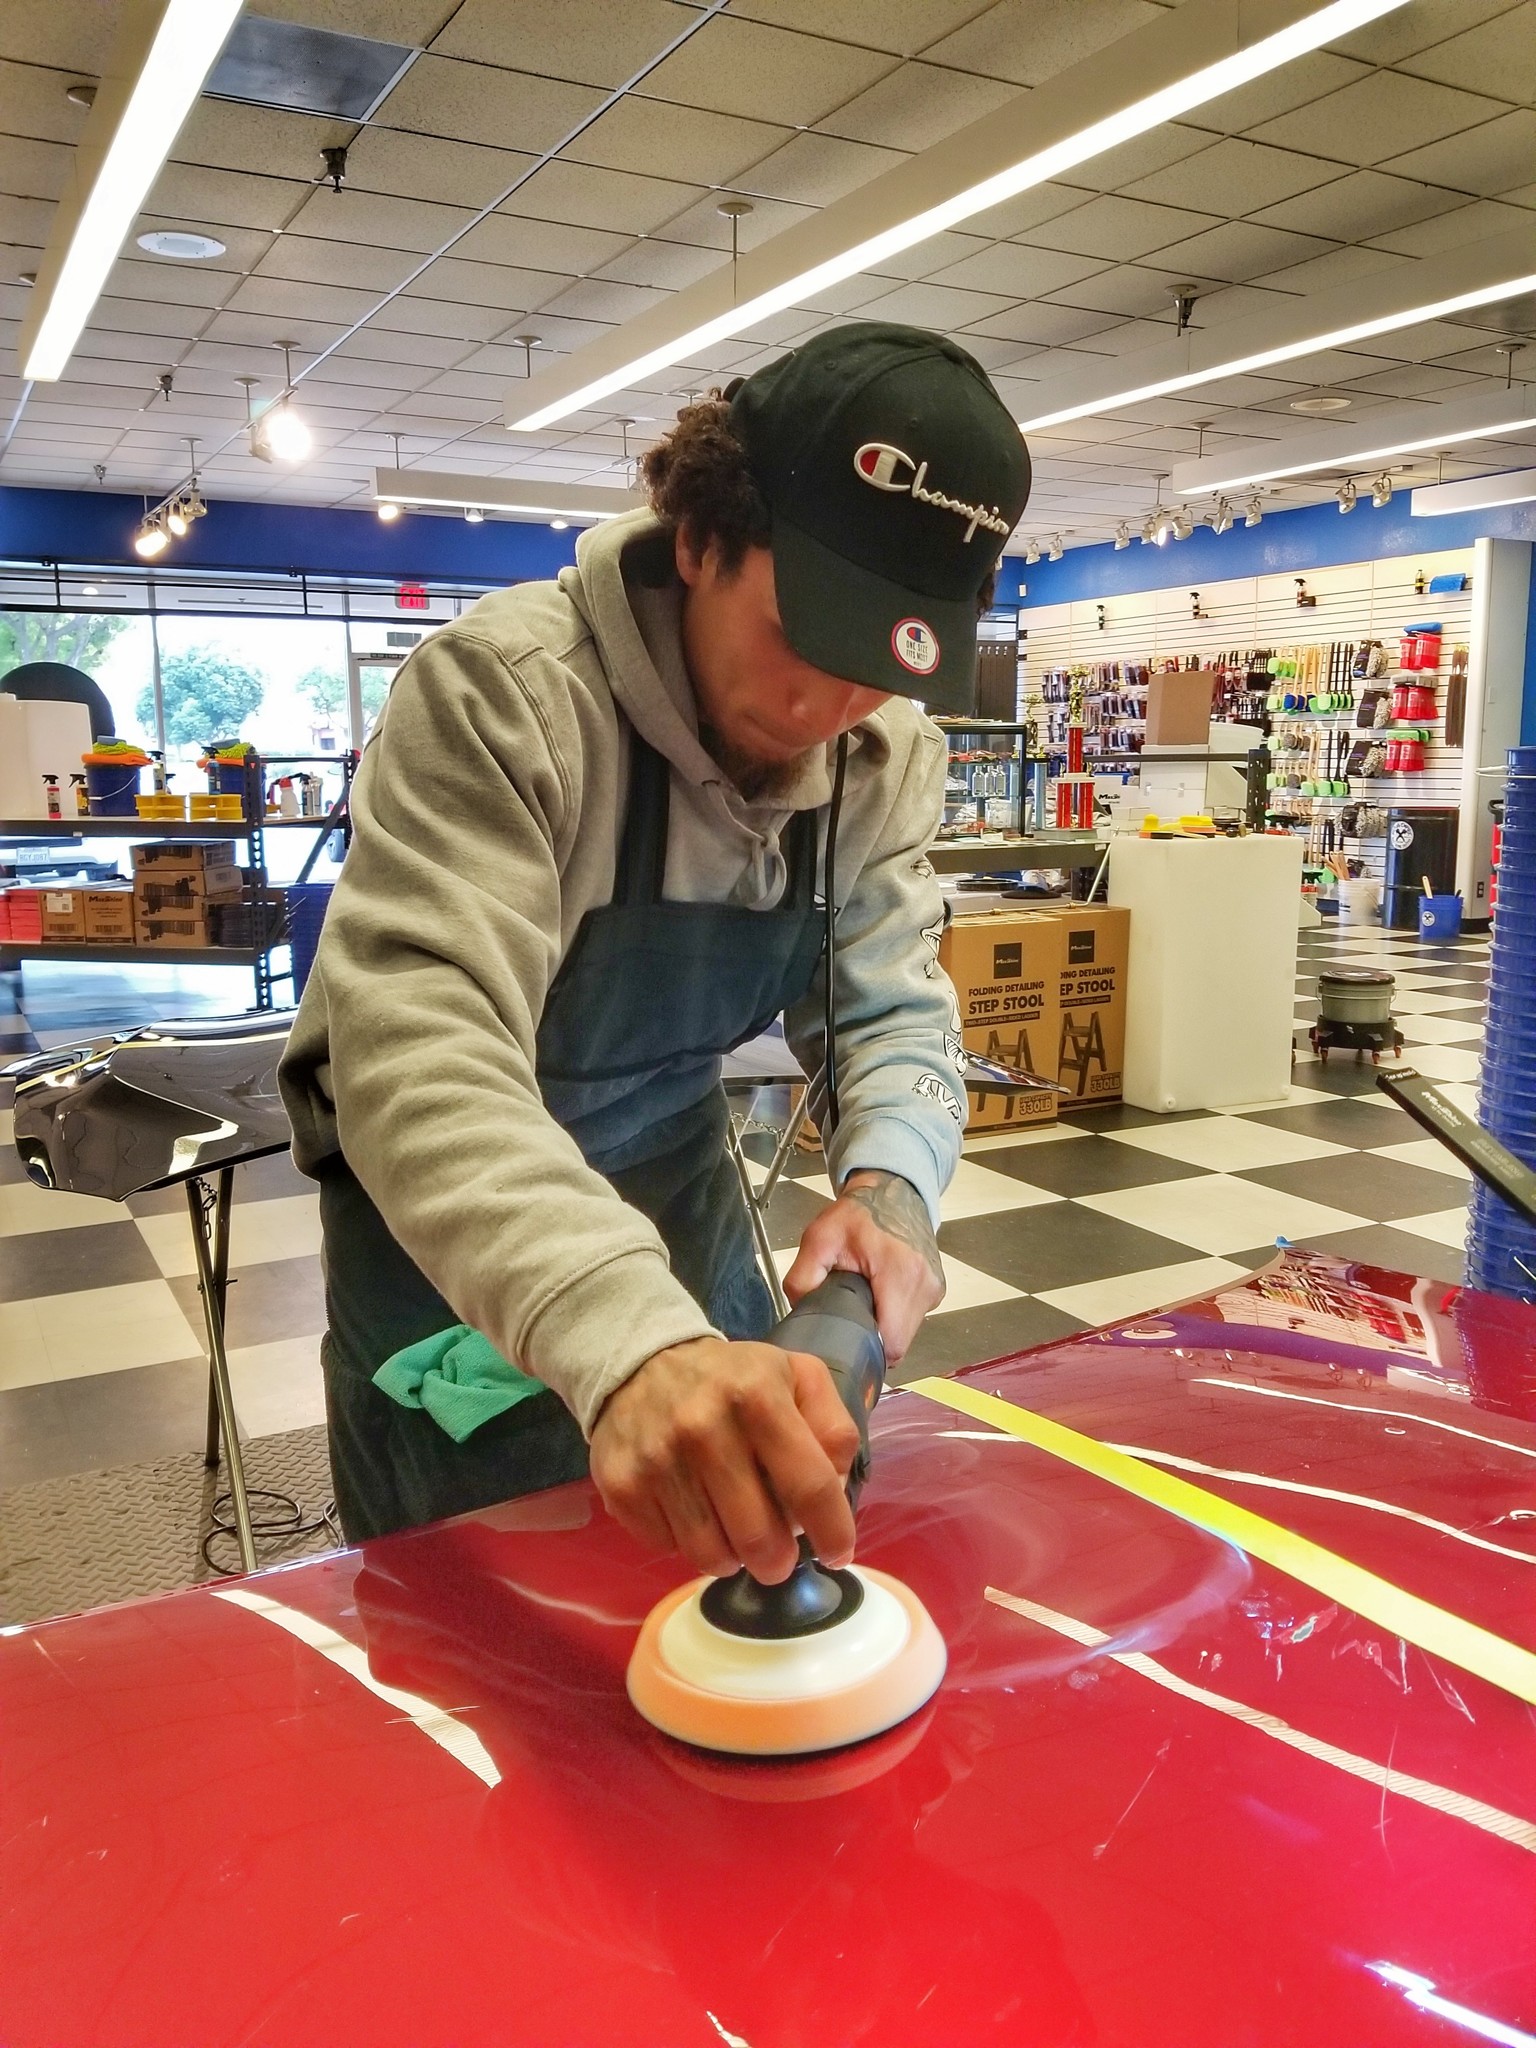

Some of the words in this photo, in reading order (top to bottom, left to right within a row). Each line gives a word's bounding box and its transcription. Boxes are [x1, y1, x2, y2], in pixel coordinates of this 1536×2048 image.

[400, 587, 425, 608] EXIT
[906, 639, 916, 651] ONE
[917, 643, 928, 655] SIZE
[1079, 967, 1115, 977] DETAILING
[968, 985, 1003, 997] FOLDING
[1005, 981, 1045, 993] DETAILING
[1077, 979, 1116, 994] STOOL
[968, 999, 999, 1015] STEP
[1003, 994, 1044, 1010] STOOL
[1090, 1077, 1121, 1093] 330LB
[1020, 1099, 1052, 1115] 330LB
